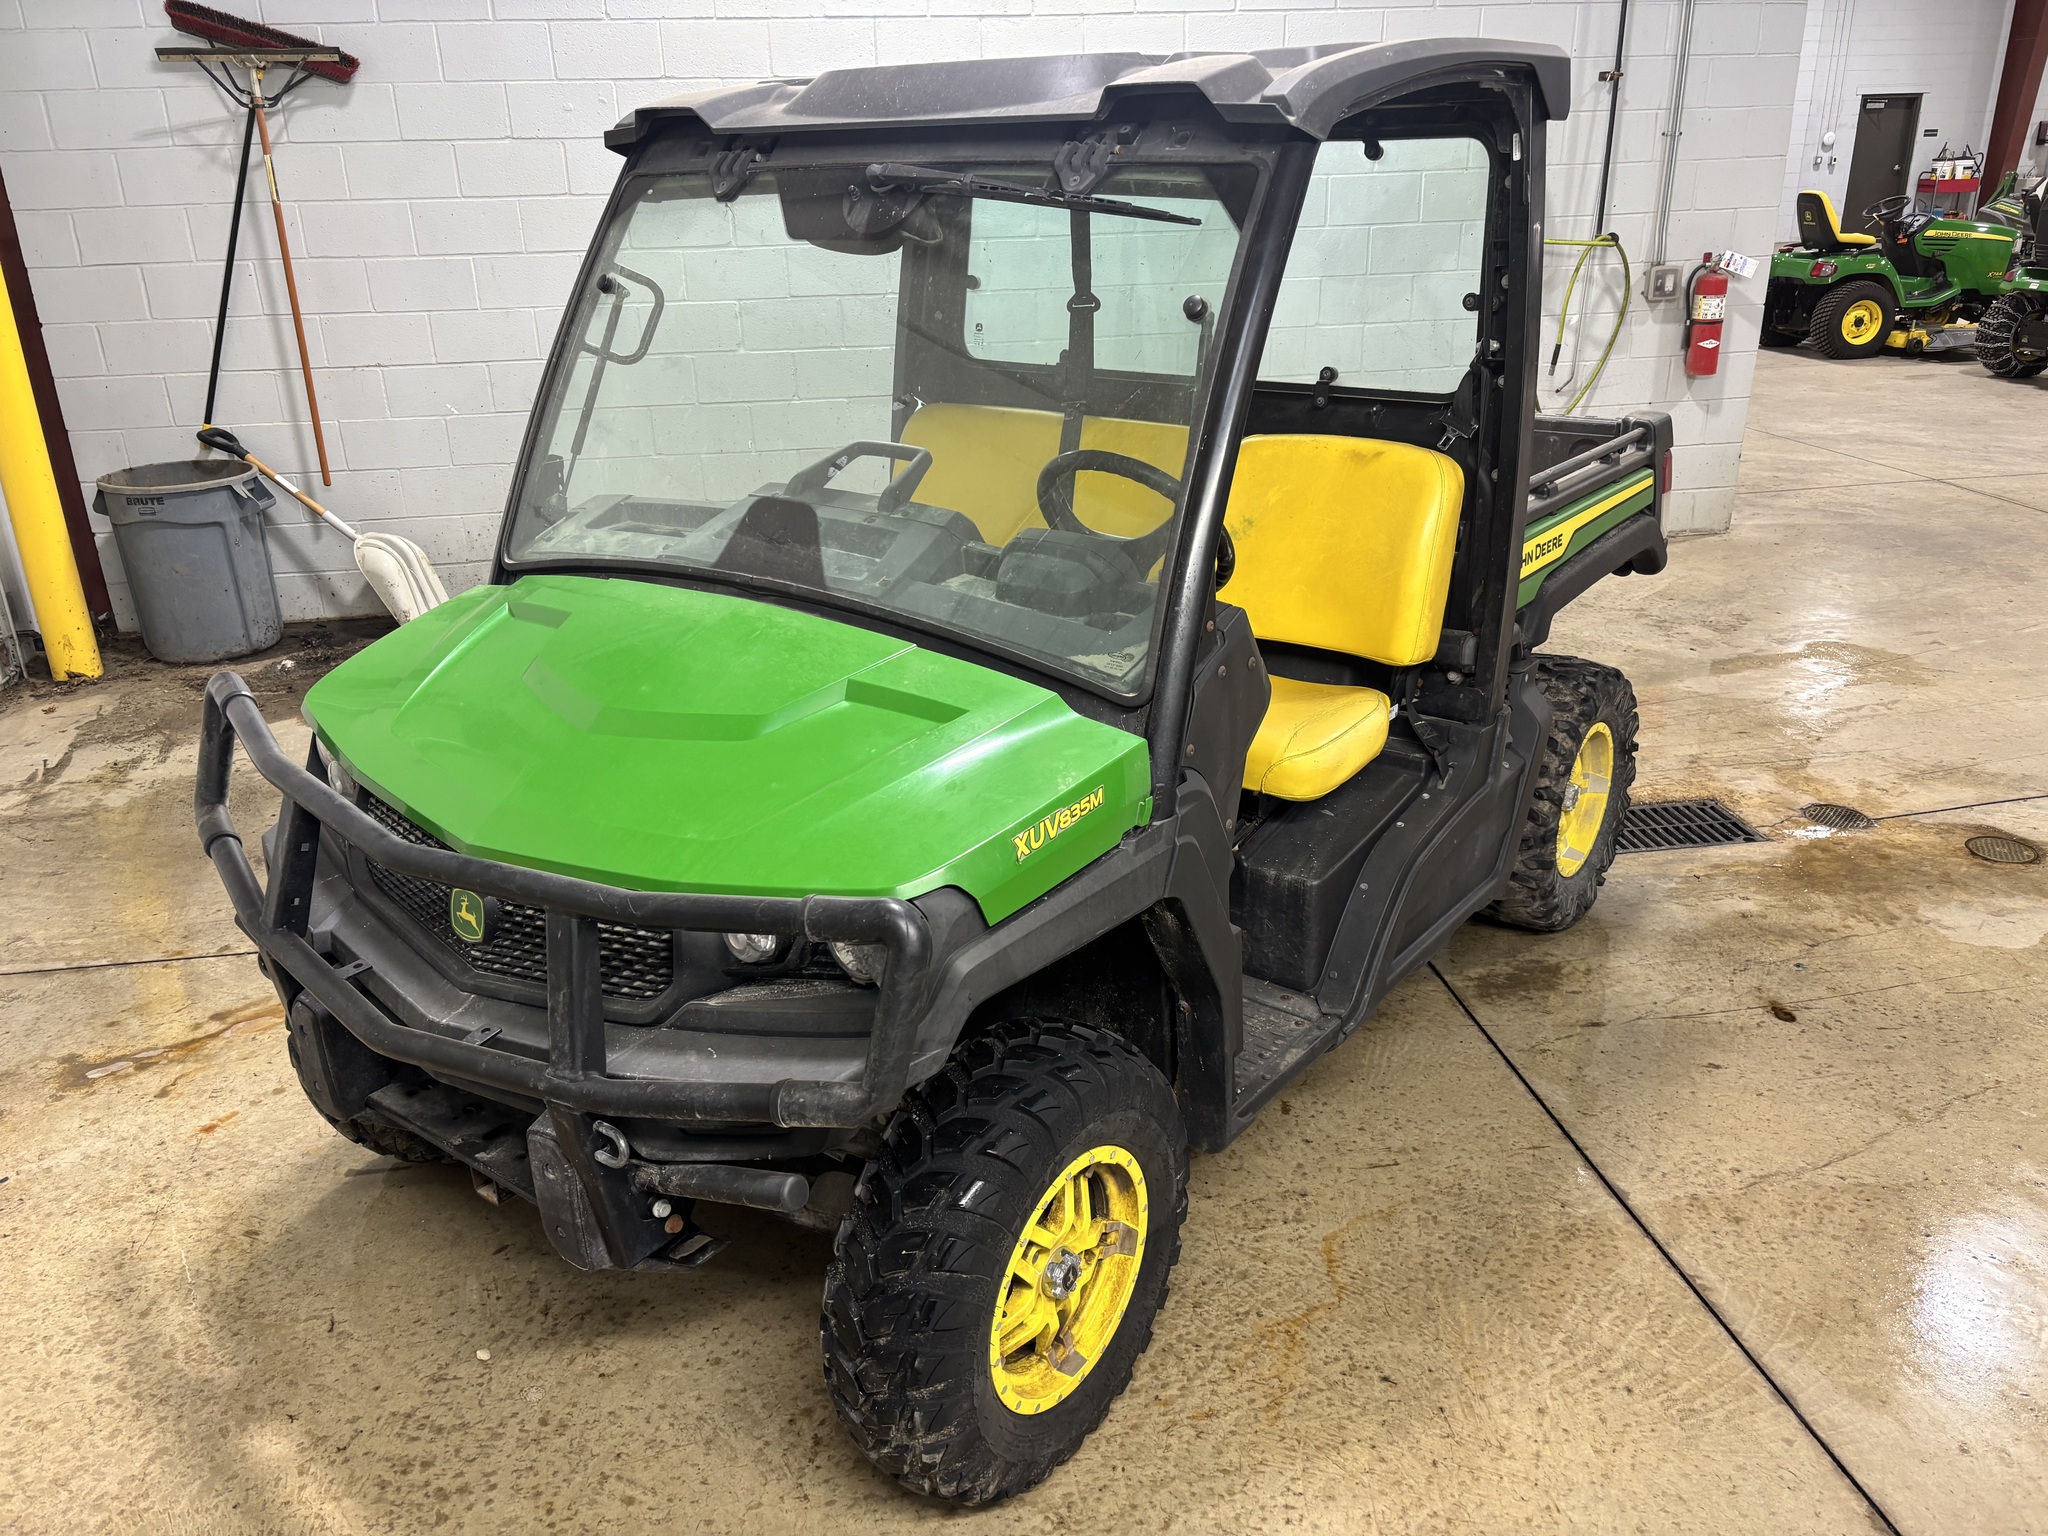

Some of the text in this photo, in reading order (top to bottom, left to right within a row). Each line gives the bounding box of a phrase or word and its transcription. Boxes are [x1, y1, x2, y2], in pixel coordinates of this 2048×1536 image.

[126, 497, 165, 506] BRUTE
[1521, 533, 1563, 566] HN DEERE
[1013, 786, 1103, 859] XUV835M
